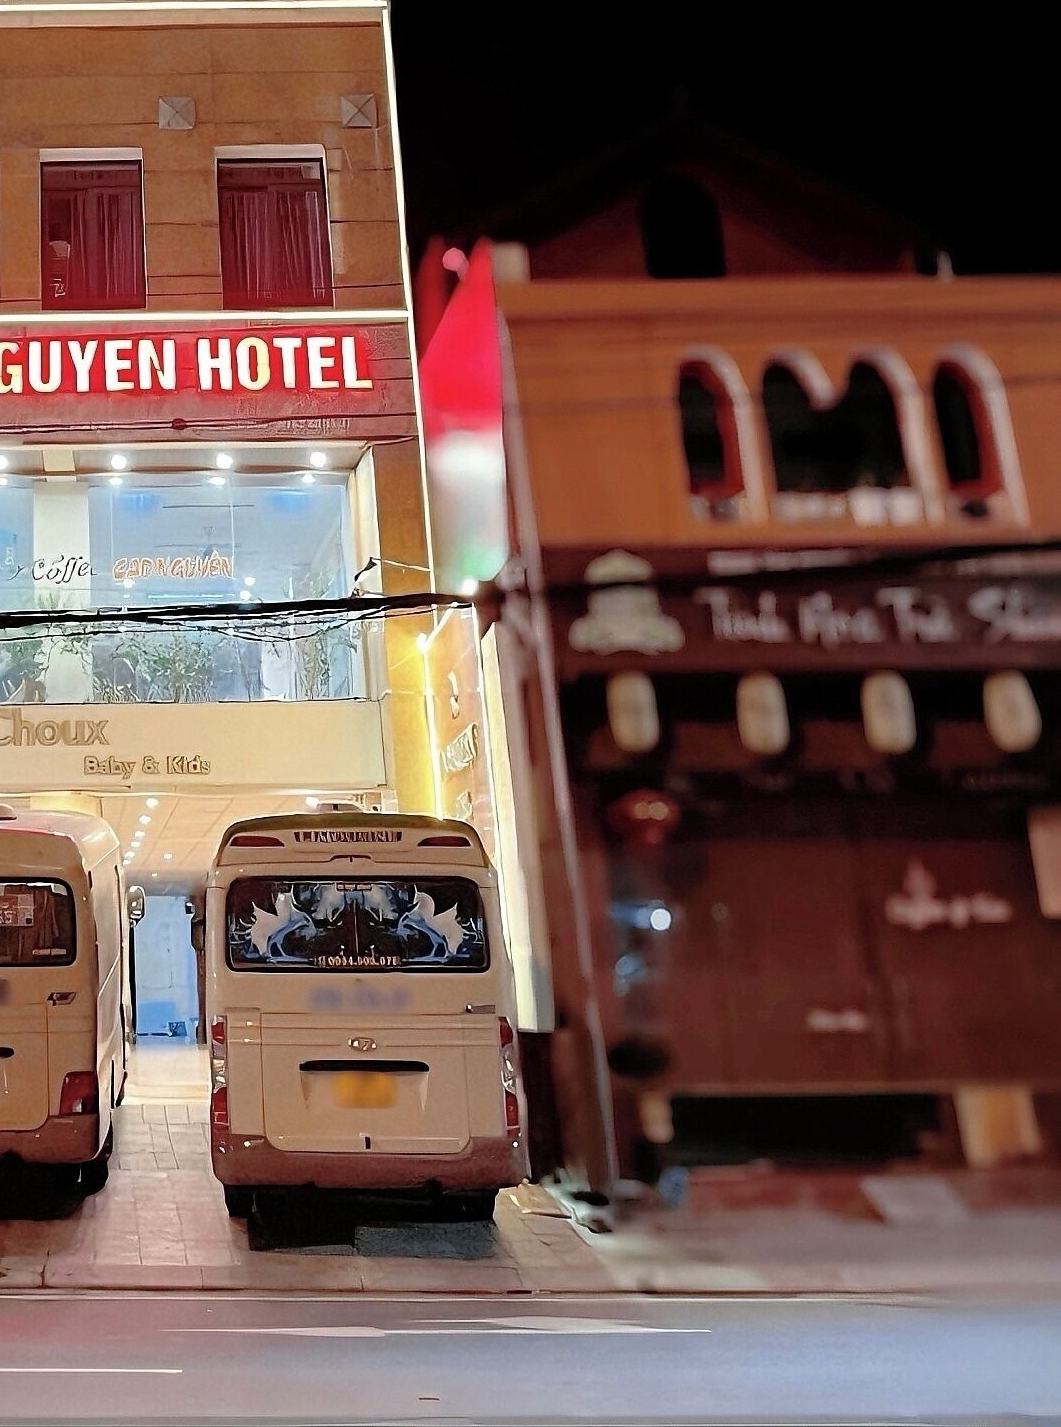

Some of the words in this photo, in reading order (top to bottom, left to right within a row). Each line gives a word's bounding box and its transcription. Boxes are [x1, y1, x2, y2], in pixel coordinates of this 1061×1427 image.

[196, 335, 374, 392] HOTEL
[83, 755, 136, 779] Baby
[142, 755, 160, 775] &
[166, 755, 212, 775] Kids
